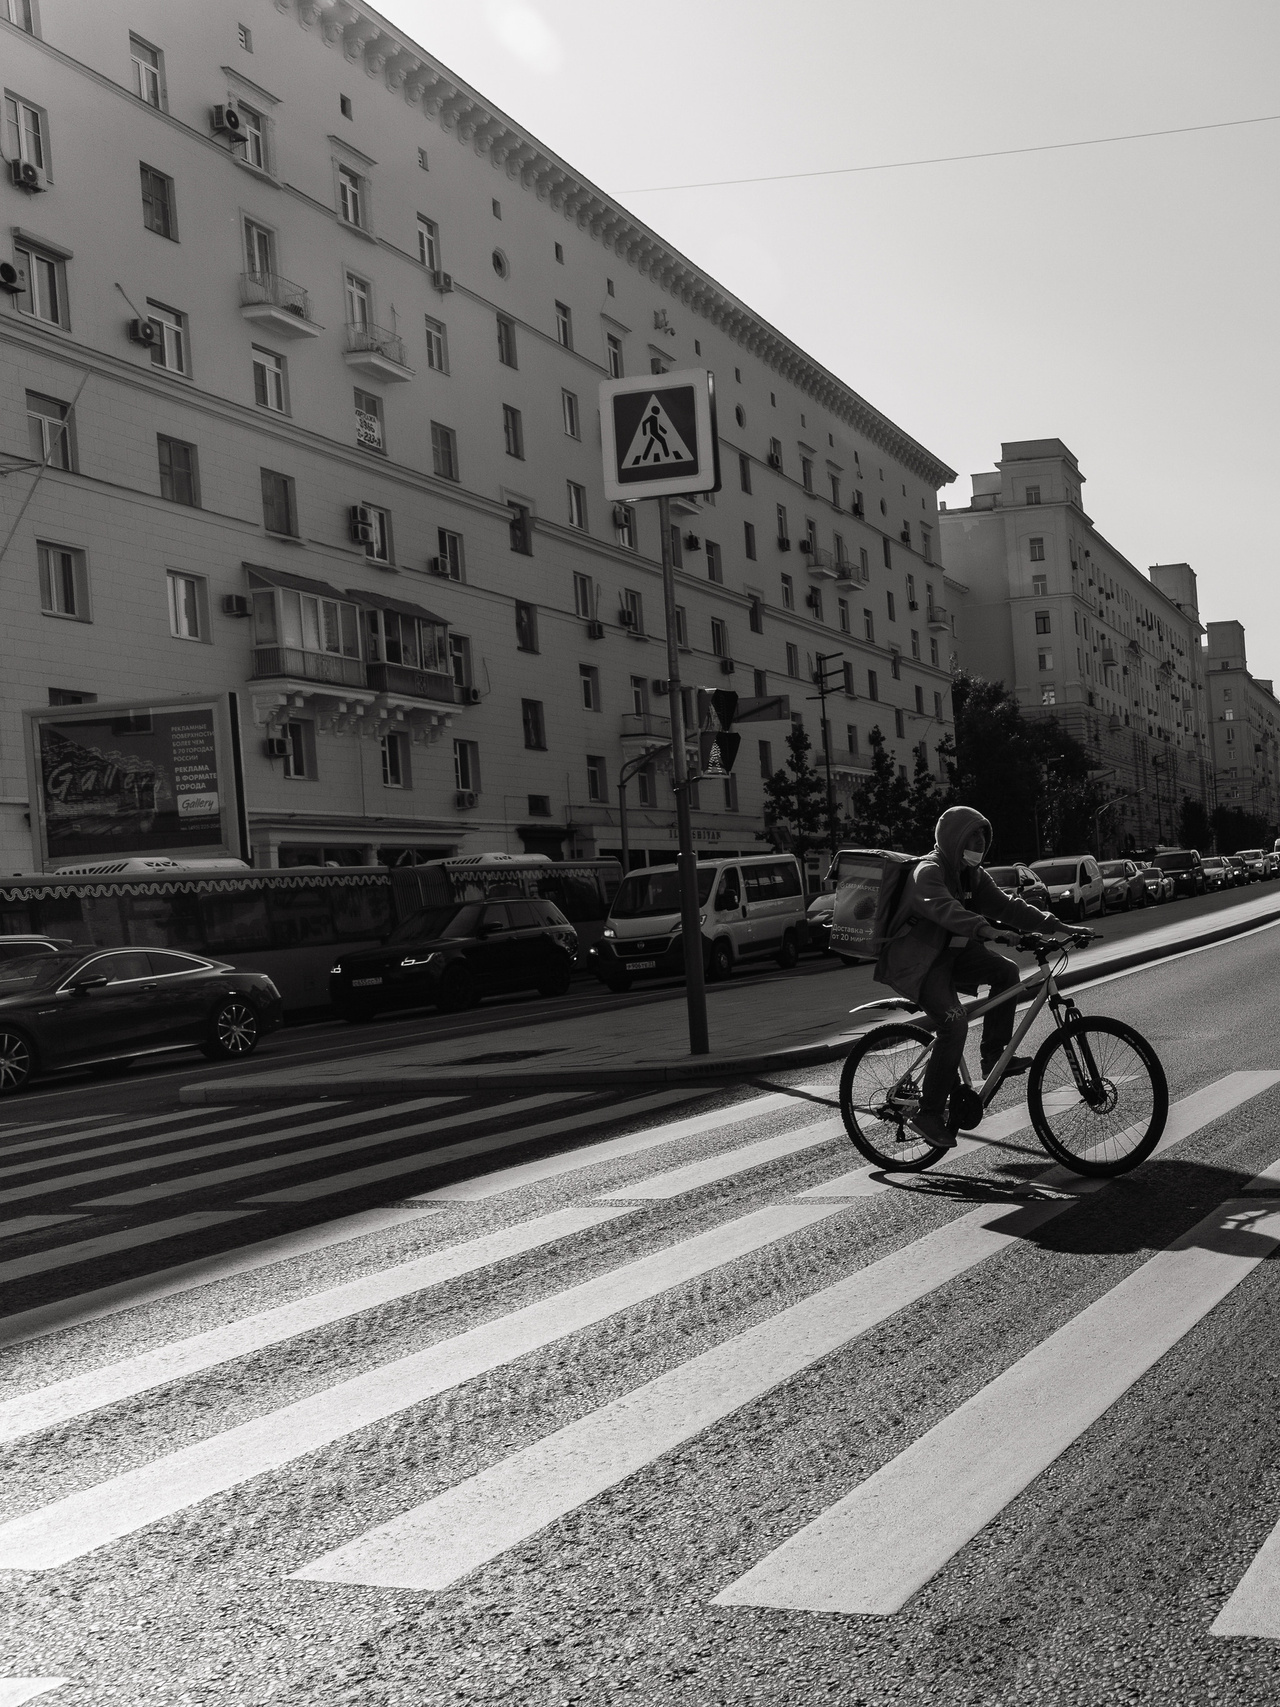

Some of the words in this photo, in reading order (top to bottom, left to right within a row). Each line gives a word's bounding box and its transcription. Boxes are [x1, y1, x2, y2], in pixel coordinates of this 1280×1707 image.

[171, 723, 207, 732] РЕКЛАМНЫЕ
[171, 730, 215, 739] ПОВЕРХНОСТИ
[175, 764, 210, 773] РЕКЛАМА
[182, 772, 217, 781] ФОРМАТЕ
[176, 782, 206, 791] ГОРОДА
[182, 798, 214, 811] Gallery
[833, 924, 864, 934] Доставка
[840, 933, 850, 941] 20
